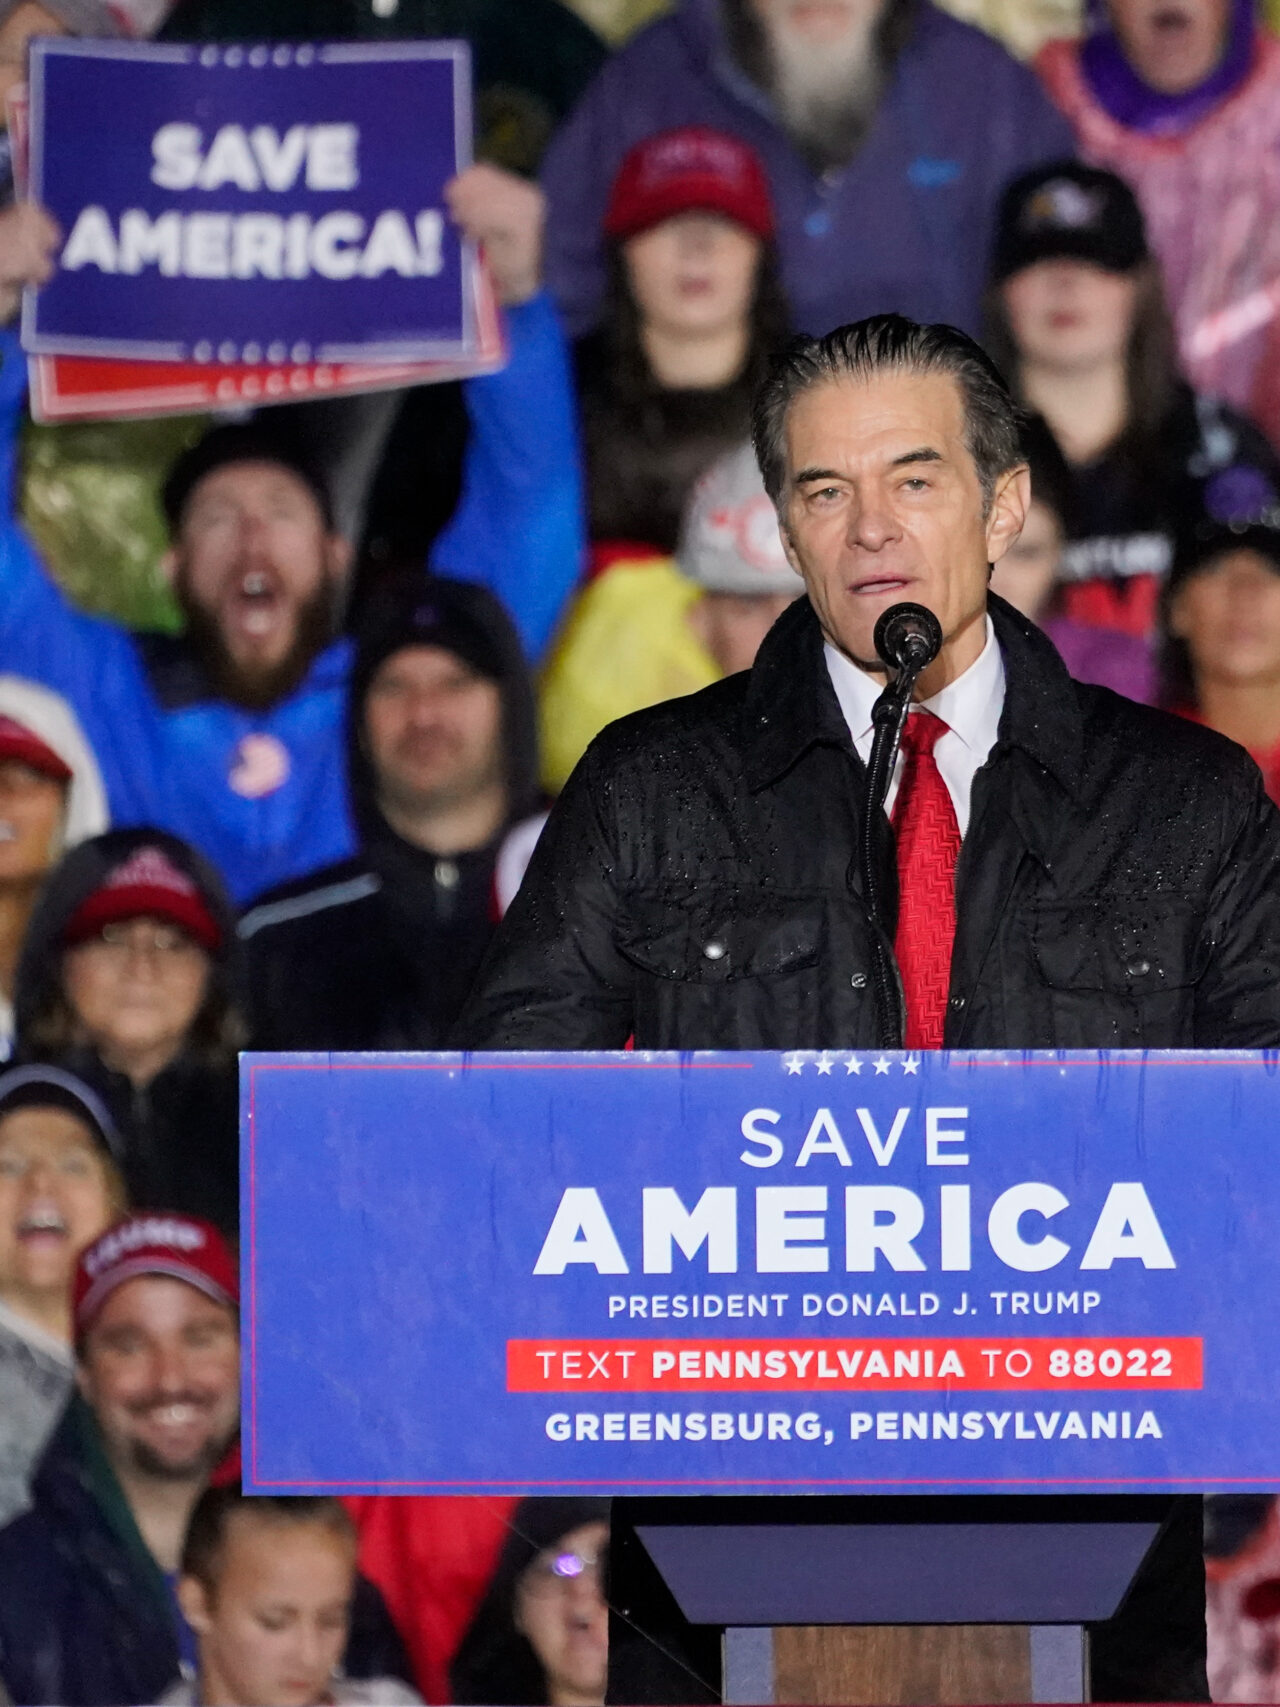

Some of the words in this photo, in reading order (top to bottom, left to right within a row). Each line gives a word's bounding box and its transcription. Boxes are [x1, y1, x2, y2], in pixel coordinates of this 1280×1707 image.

[150, 121, 360, 192] SAVE
[60, 203, 444, 281] AMERICA!
[739, 1107, 969, 1168] SAVE
[532, 1182, 1177, 1275] AMERICA
[608, 1294, 789, 1319] PRESIDENT
[802, 1292, 940, 1317] DONALD
[953, 1292, 977, 1316] J.
[990, 1291, 1101, 1315] TRUMP
[536, 1350, 636, 1379] TEXT
[652, 1349, 966, 1379] PENNSYLVANIA
[981, 1348, 1033, 1378] TO
[1048, 1348, 1173, 1378] 88022
[545, 1412, 834, 1446] GREENSBURG,
[850, 1410, 1163, 1440] PENNSYLVANIA
